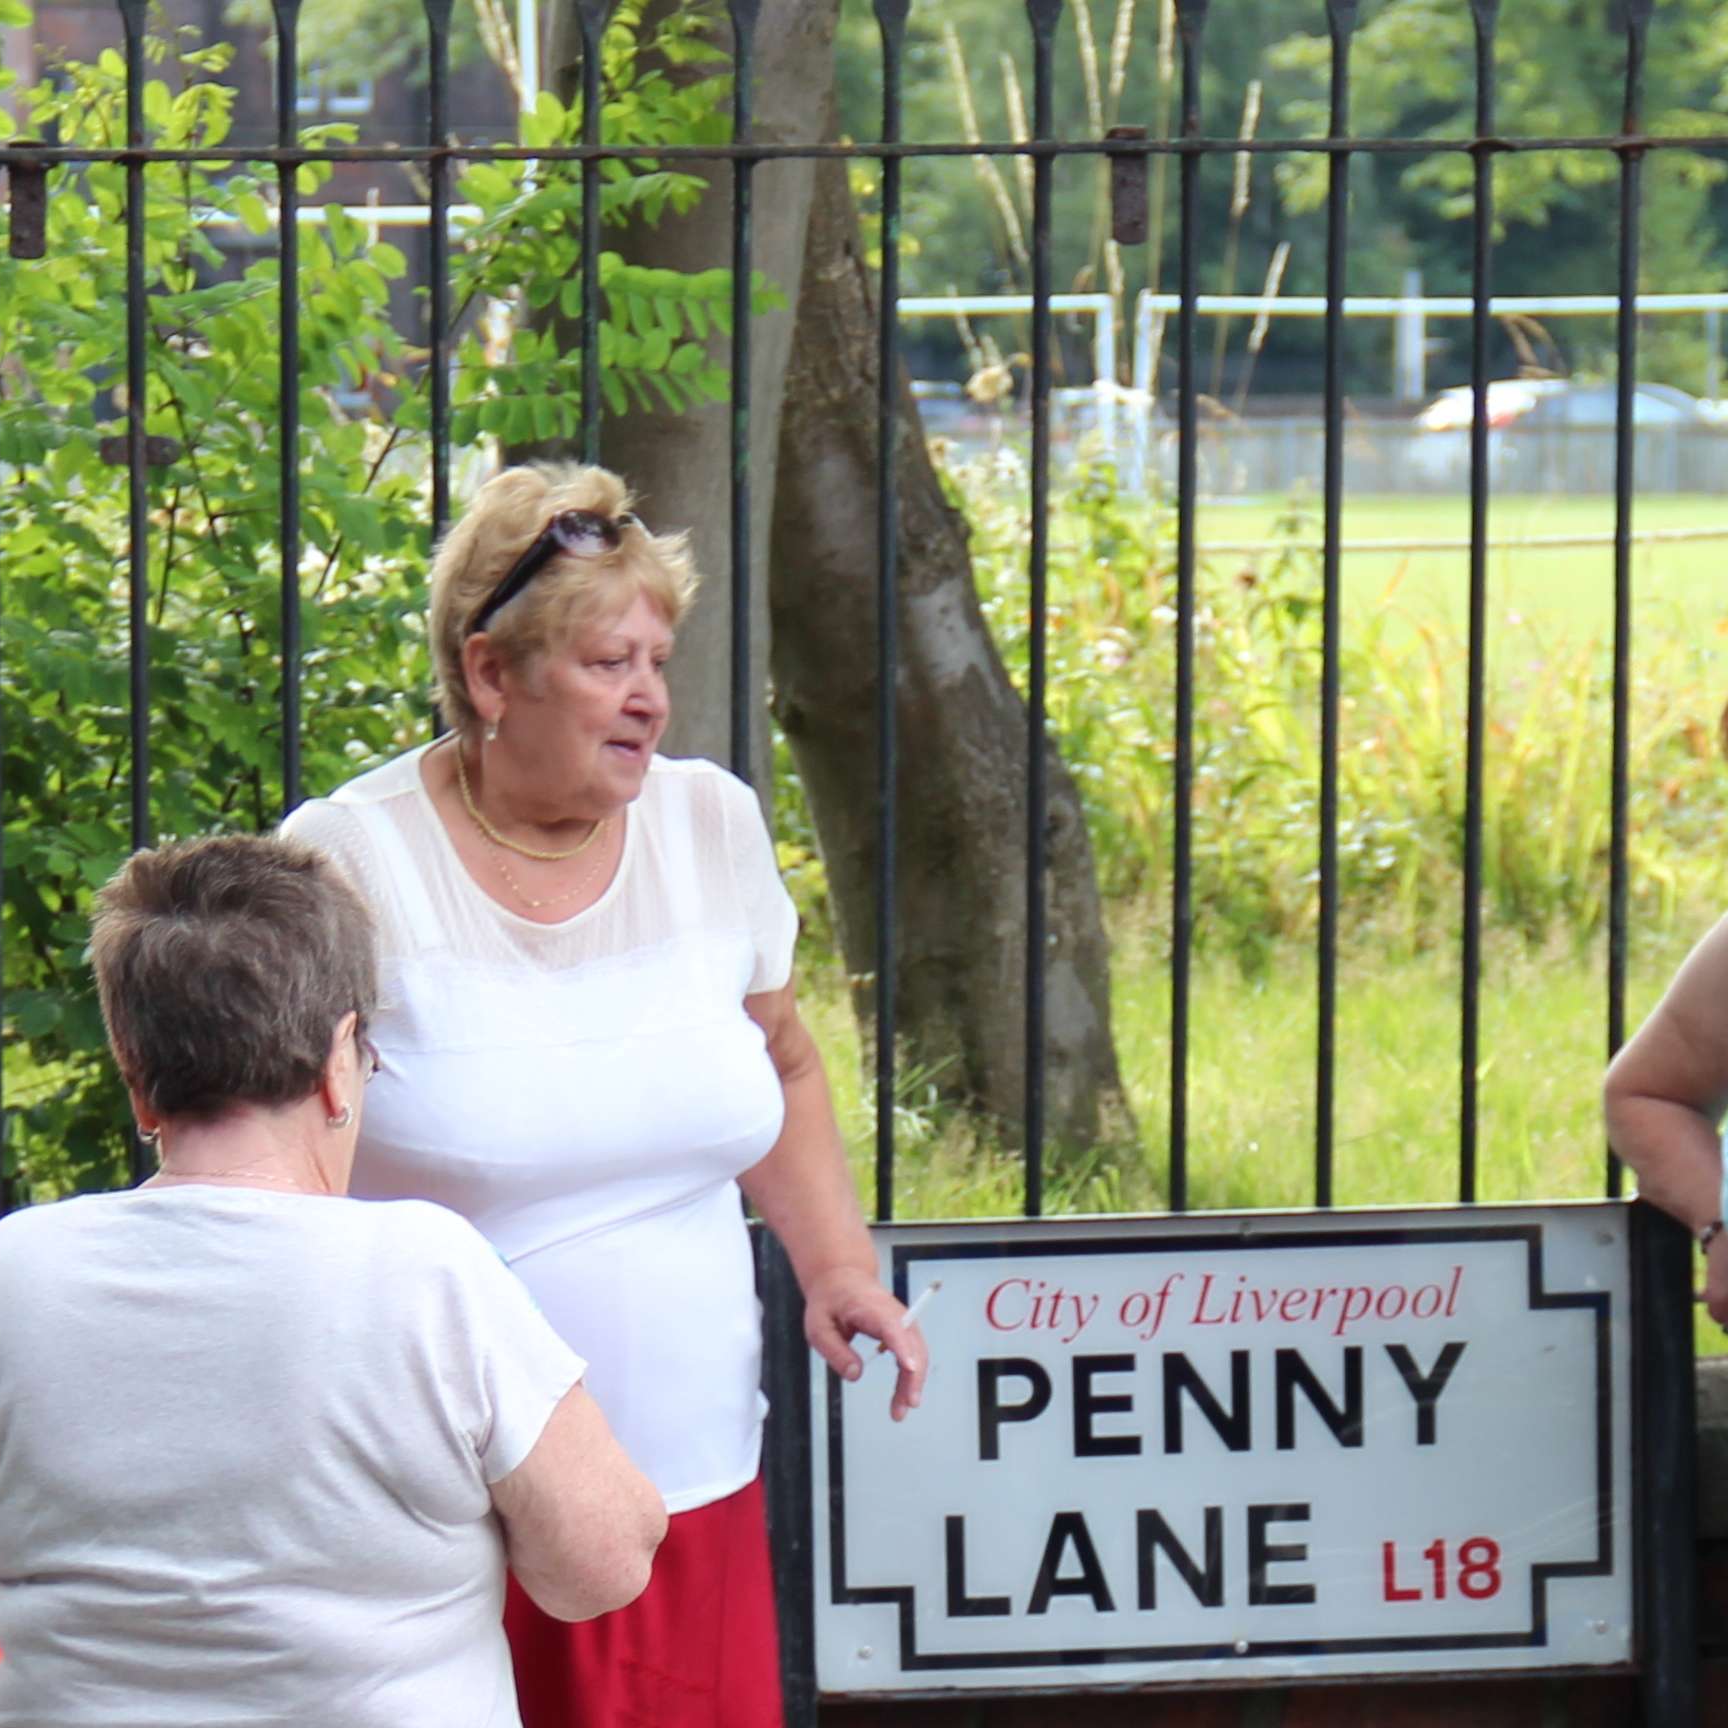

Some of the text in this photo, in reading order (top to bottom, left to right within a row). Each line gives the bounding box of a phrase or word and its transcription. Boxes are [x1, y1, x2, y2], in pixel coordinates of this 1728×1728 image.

[984, 1265, 1464, 1344] City of Liverpool
[976, 1341, 1468, 1462] PENNY
[944, 1502, 1318, 1619] LANE
[1382, 1537, 1502, 1602] L18
